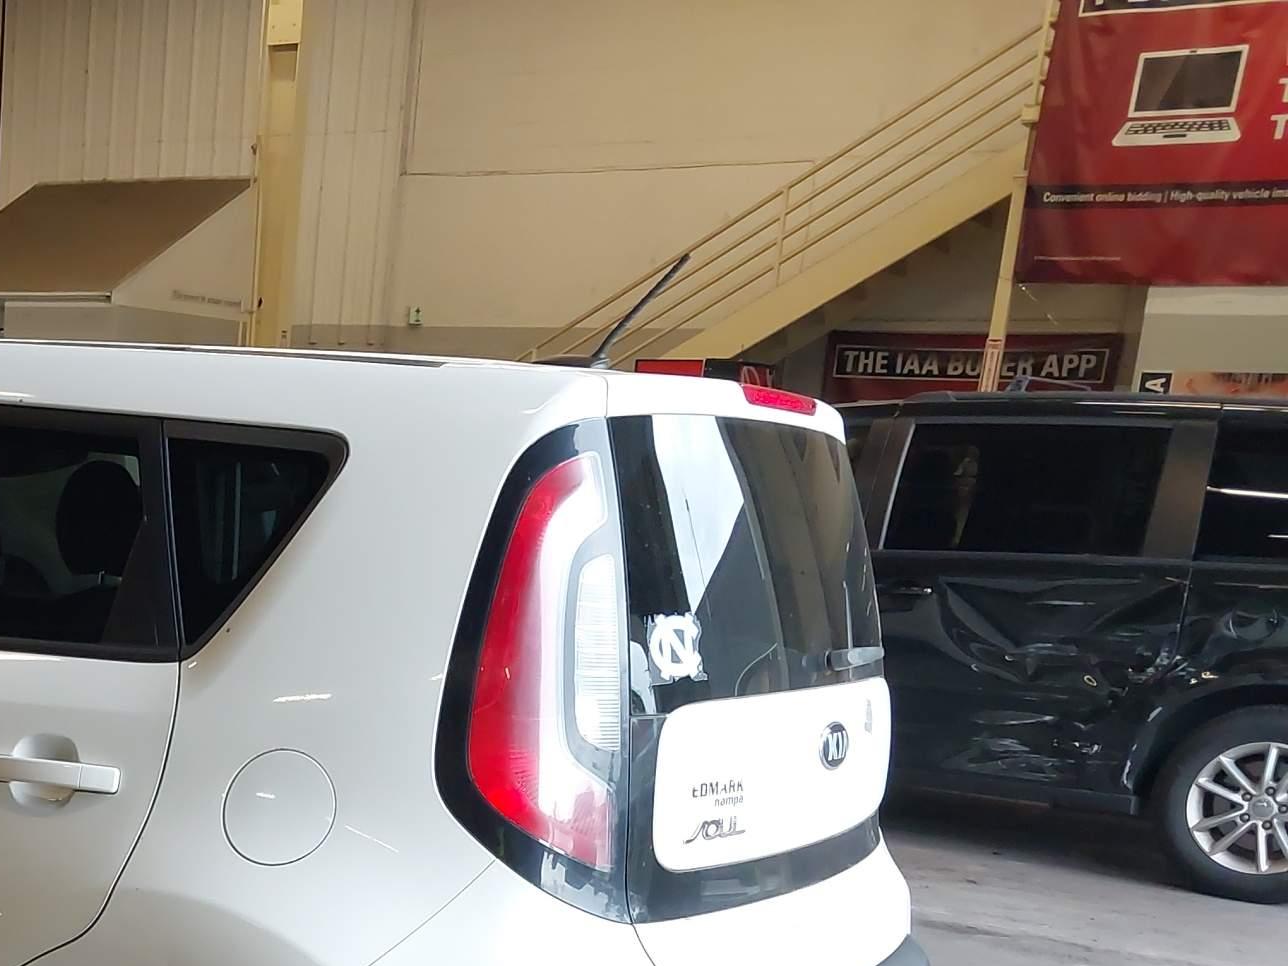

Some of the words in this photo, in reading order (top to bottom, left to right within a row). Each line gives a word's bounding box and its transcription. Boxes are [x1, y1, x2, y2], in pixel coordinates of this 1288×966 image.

[1042, 191, 1095, 203] Convenient
[1095, 191, 1125, 202] online
[1127, 190, 1162, 203] bidding
[1170, 189, 1230, 203] High-quality
[1232, 188, 1270, 199] vehicle
[844, 350, 889, 374] THE
[896, 353, 939, 376] IAA
[947, 354, 1033, 377] BUER
[1041, 354, 1097, 378] APP
